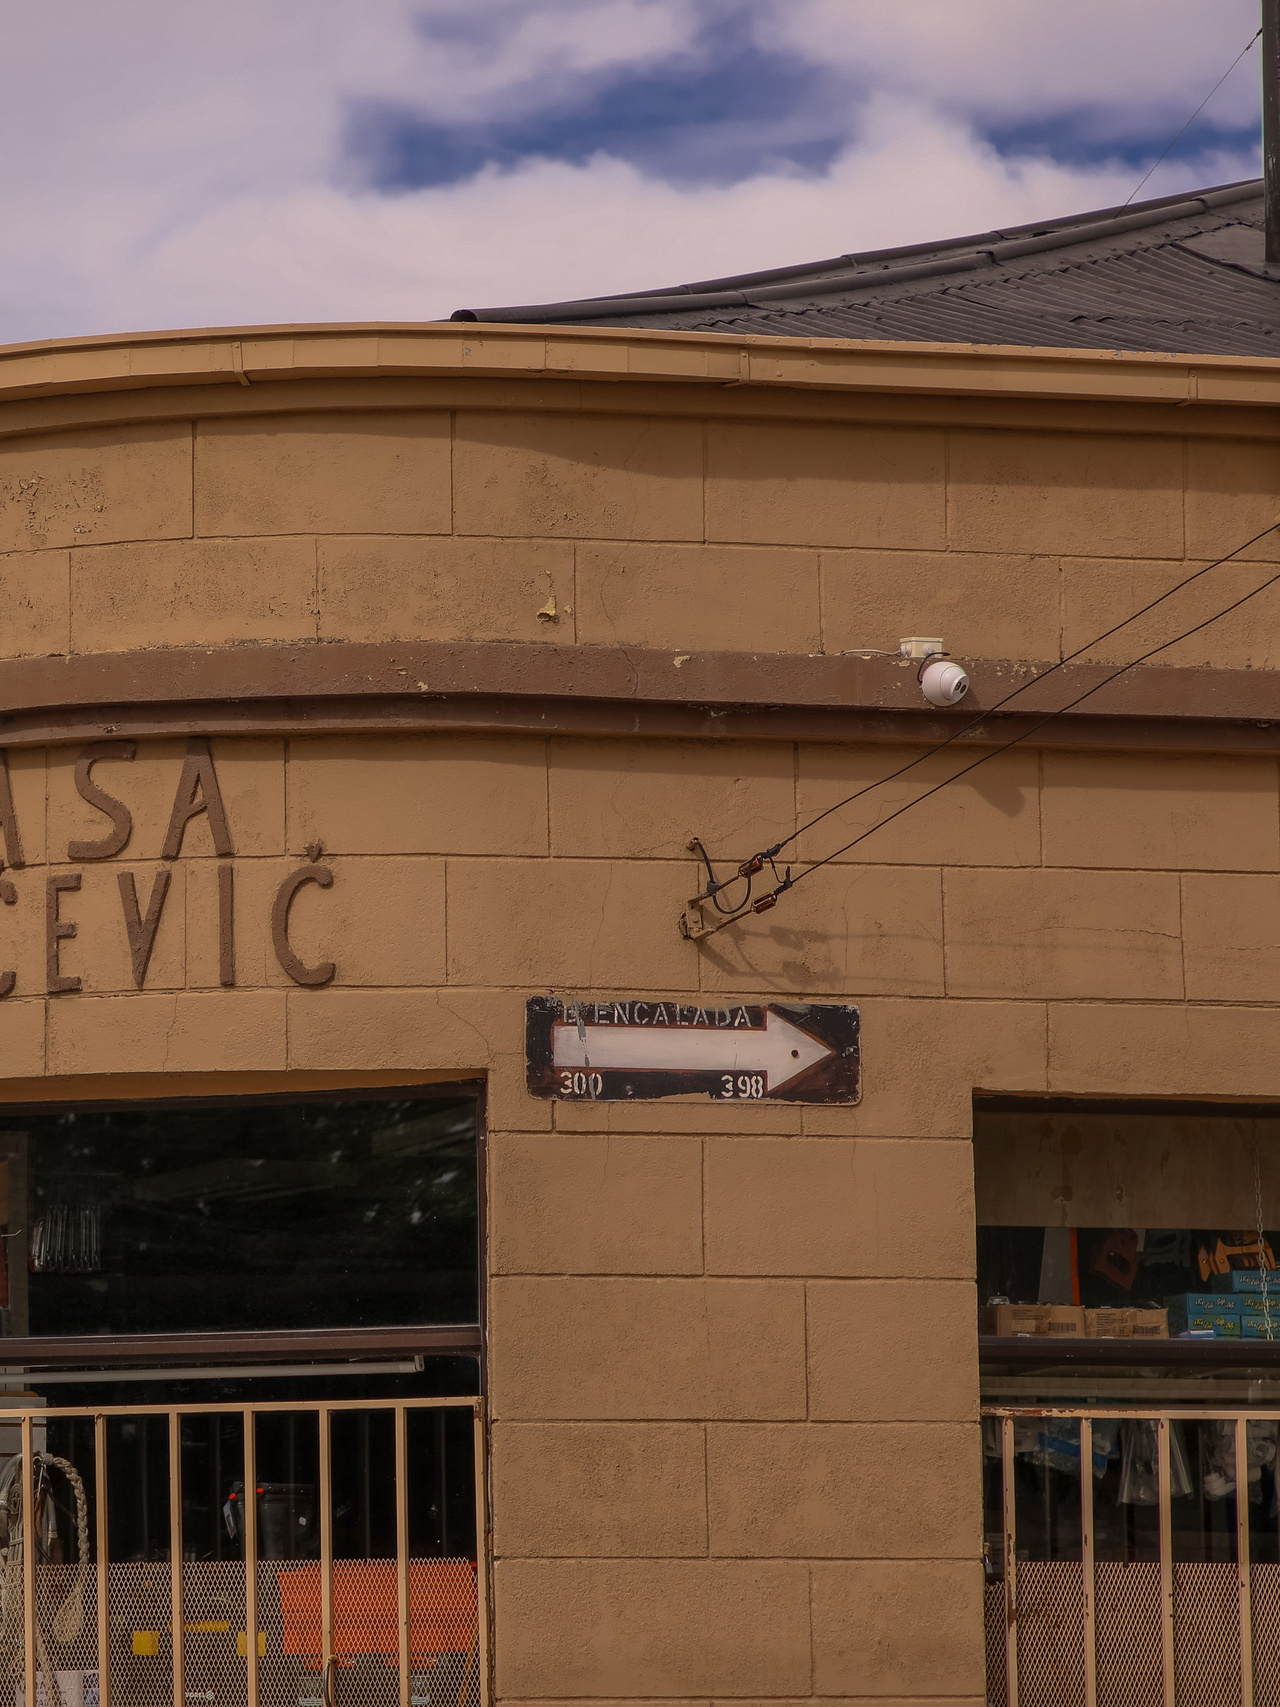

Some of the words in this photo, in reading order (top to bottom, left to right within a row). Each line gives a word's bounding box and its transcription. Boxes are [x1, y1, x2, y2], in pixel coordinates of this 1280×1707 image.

[594, 1000, 752, 1028] ENCALADA
[560, 1071, 603, 1097] 300
[720, 1074, 765, 1099] 398
